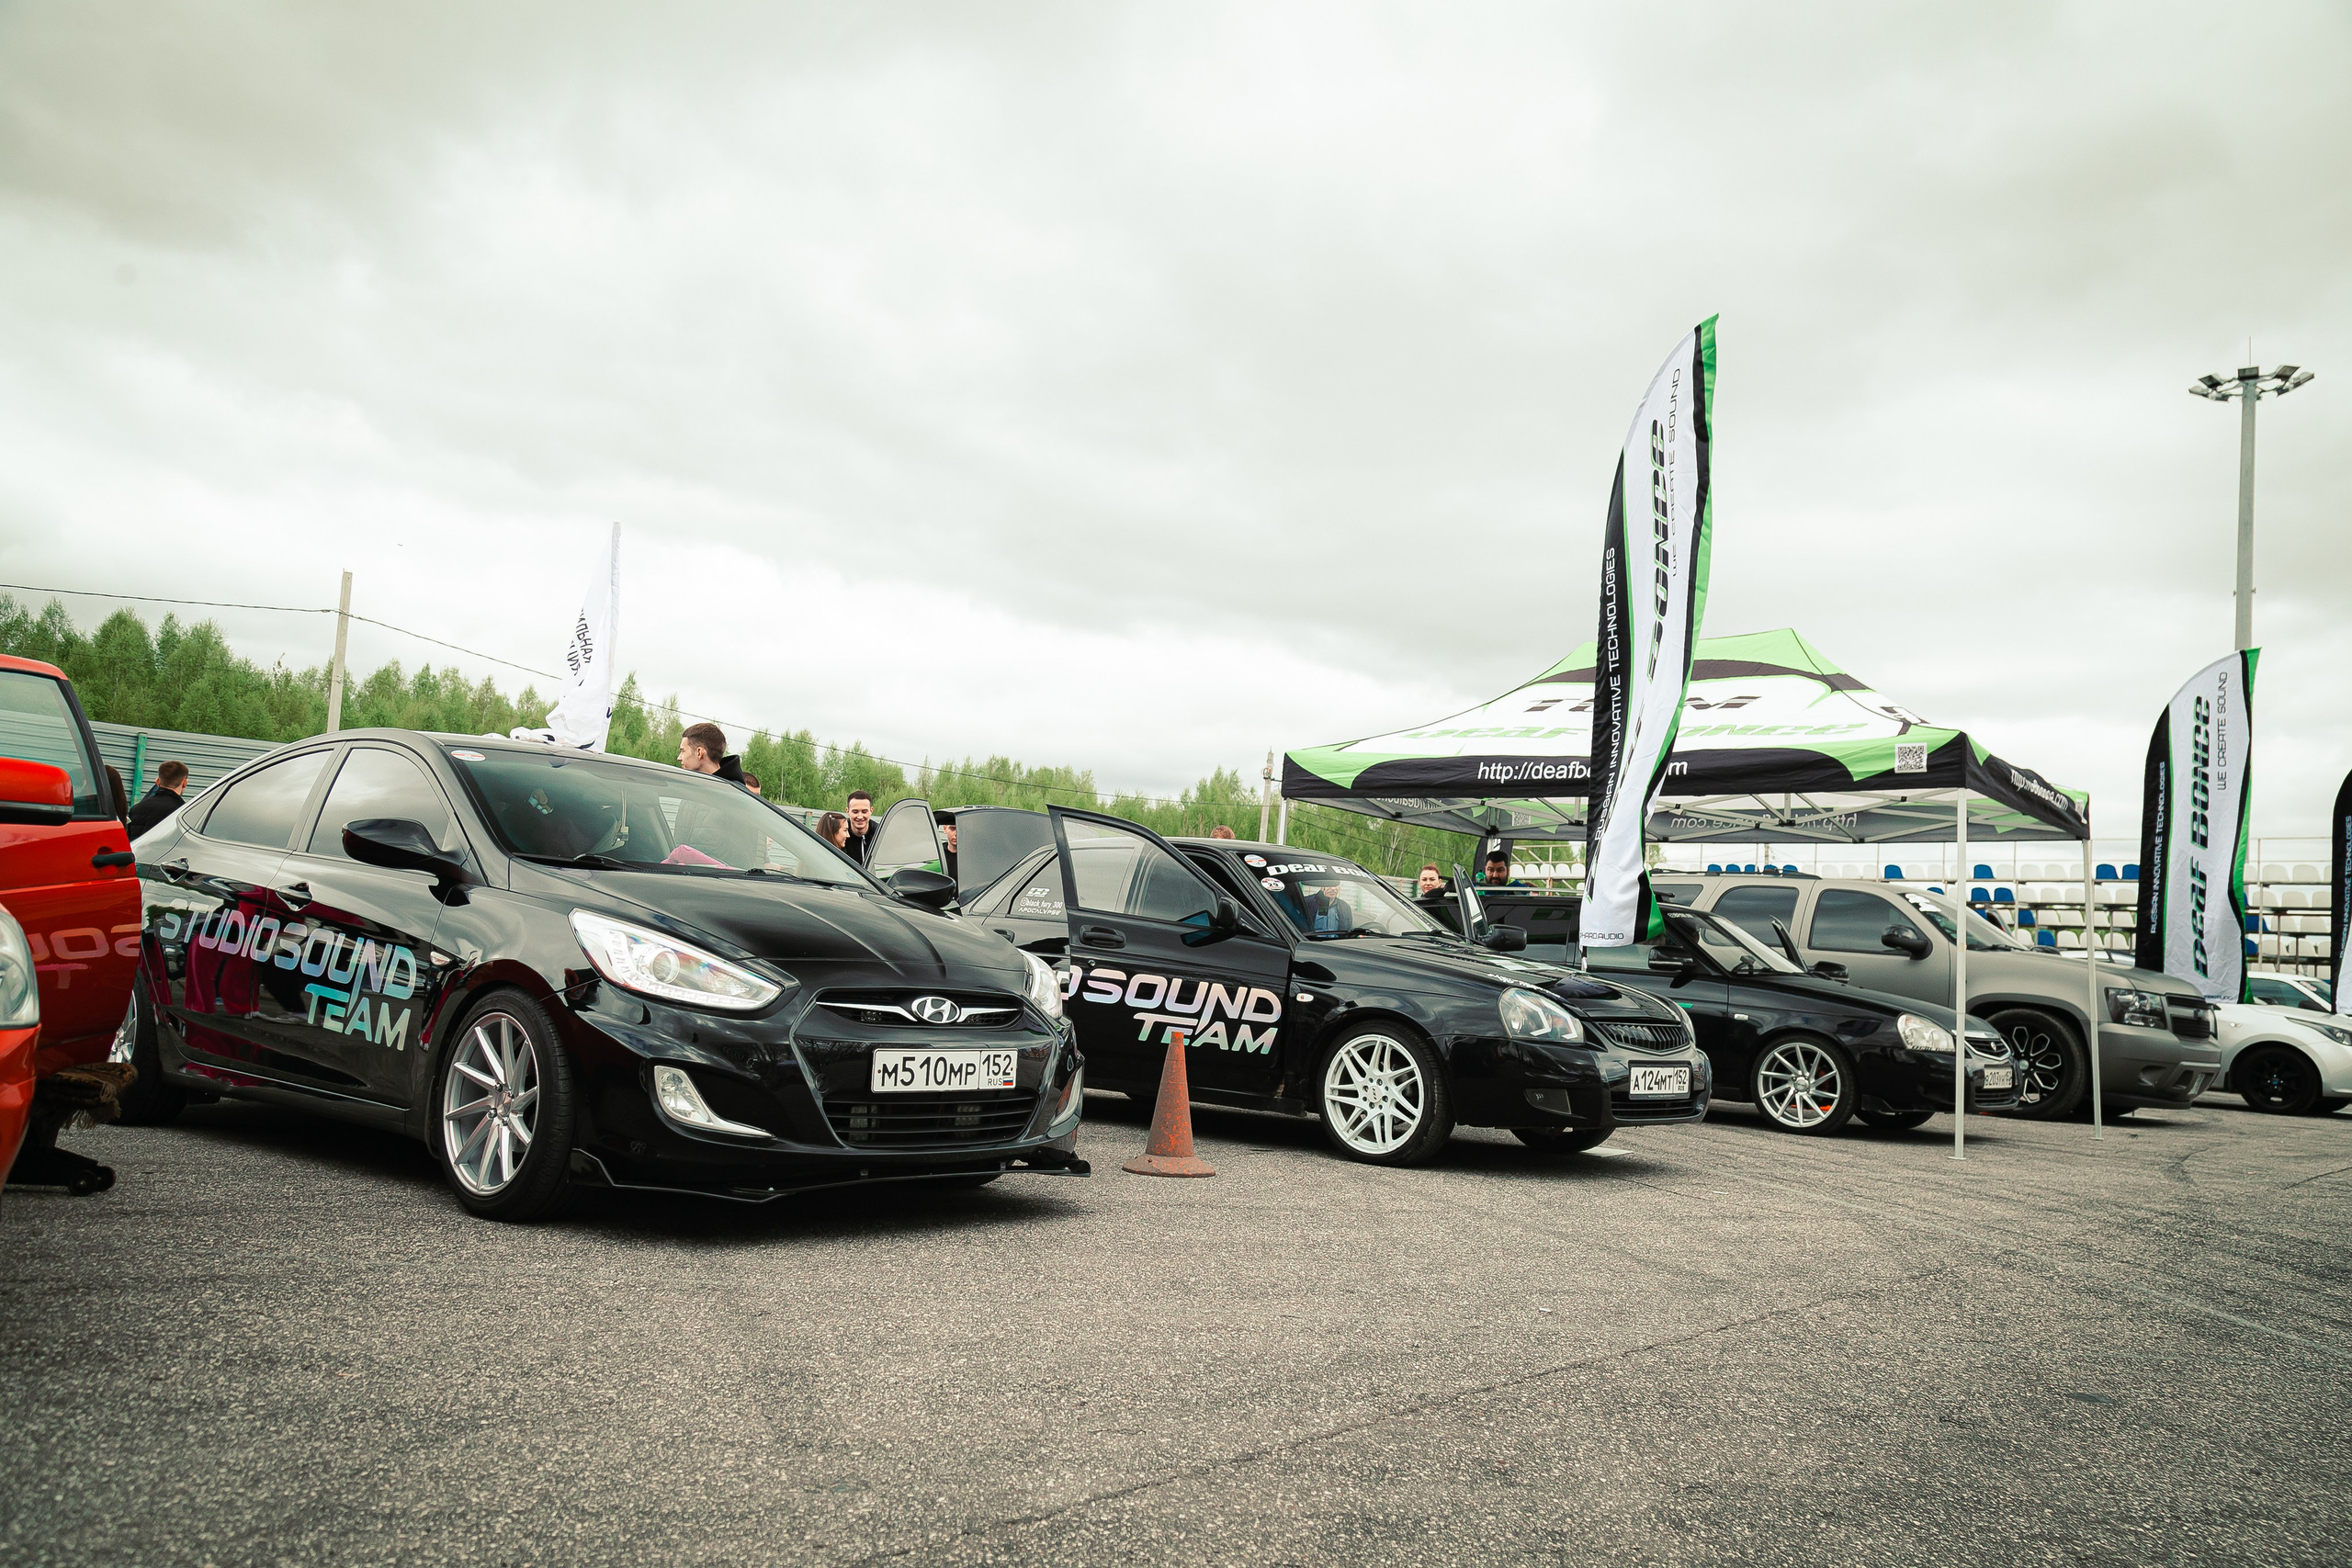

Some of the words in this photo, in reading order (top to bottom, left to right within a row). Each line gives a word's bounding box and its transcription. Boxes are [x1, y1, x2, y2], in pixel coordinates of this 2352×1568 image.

[1668, 368, 1680, 443] SOUND
[1606, 547, 1619, 672] TECHNOLOGIES
[2217, 671, 2228, 714] SOUND
[1610, 674, 1622, 769] INNOVATIVE
[2217, 718, 2227, 767] CREATE
[1594, 772, 1616, 841] RUSSIAN
[2155, 761, 2165, 834] TECHNOLOGIES
[2217, 771, 2227, 791] WE
[2153, 835, 2163, 891] INNOVATIVE
[1018, 908, 1061, 916] APOCALYPSE
[2150, 892, 2159, 934] RUSSIAN
[160, 898, 417, 1017] STUDIOSOUND
[305, 983, 412, 1051] TEAM
[1133, 1012, 1278, 1055] TEAM
[982, 1055, 1012, 1077] 152
[1674, 1069, 1687, 1085] 152
